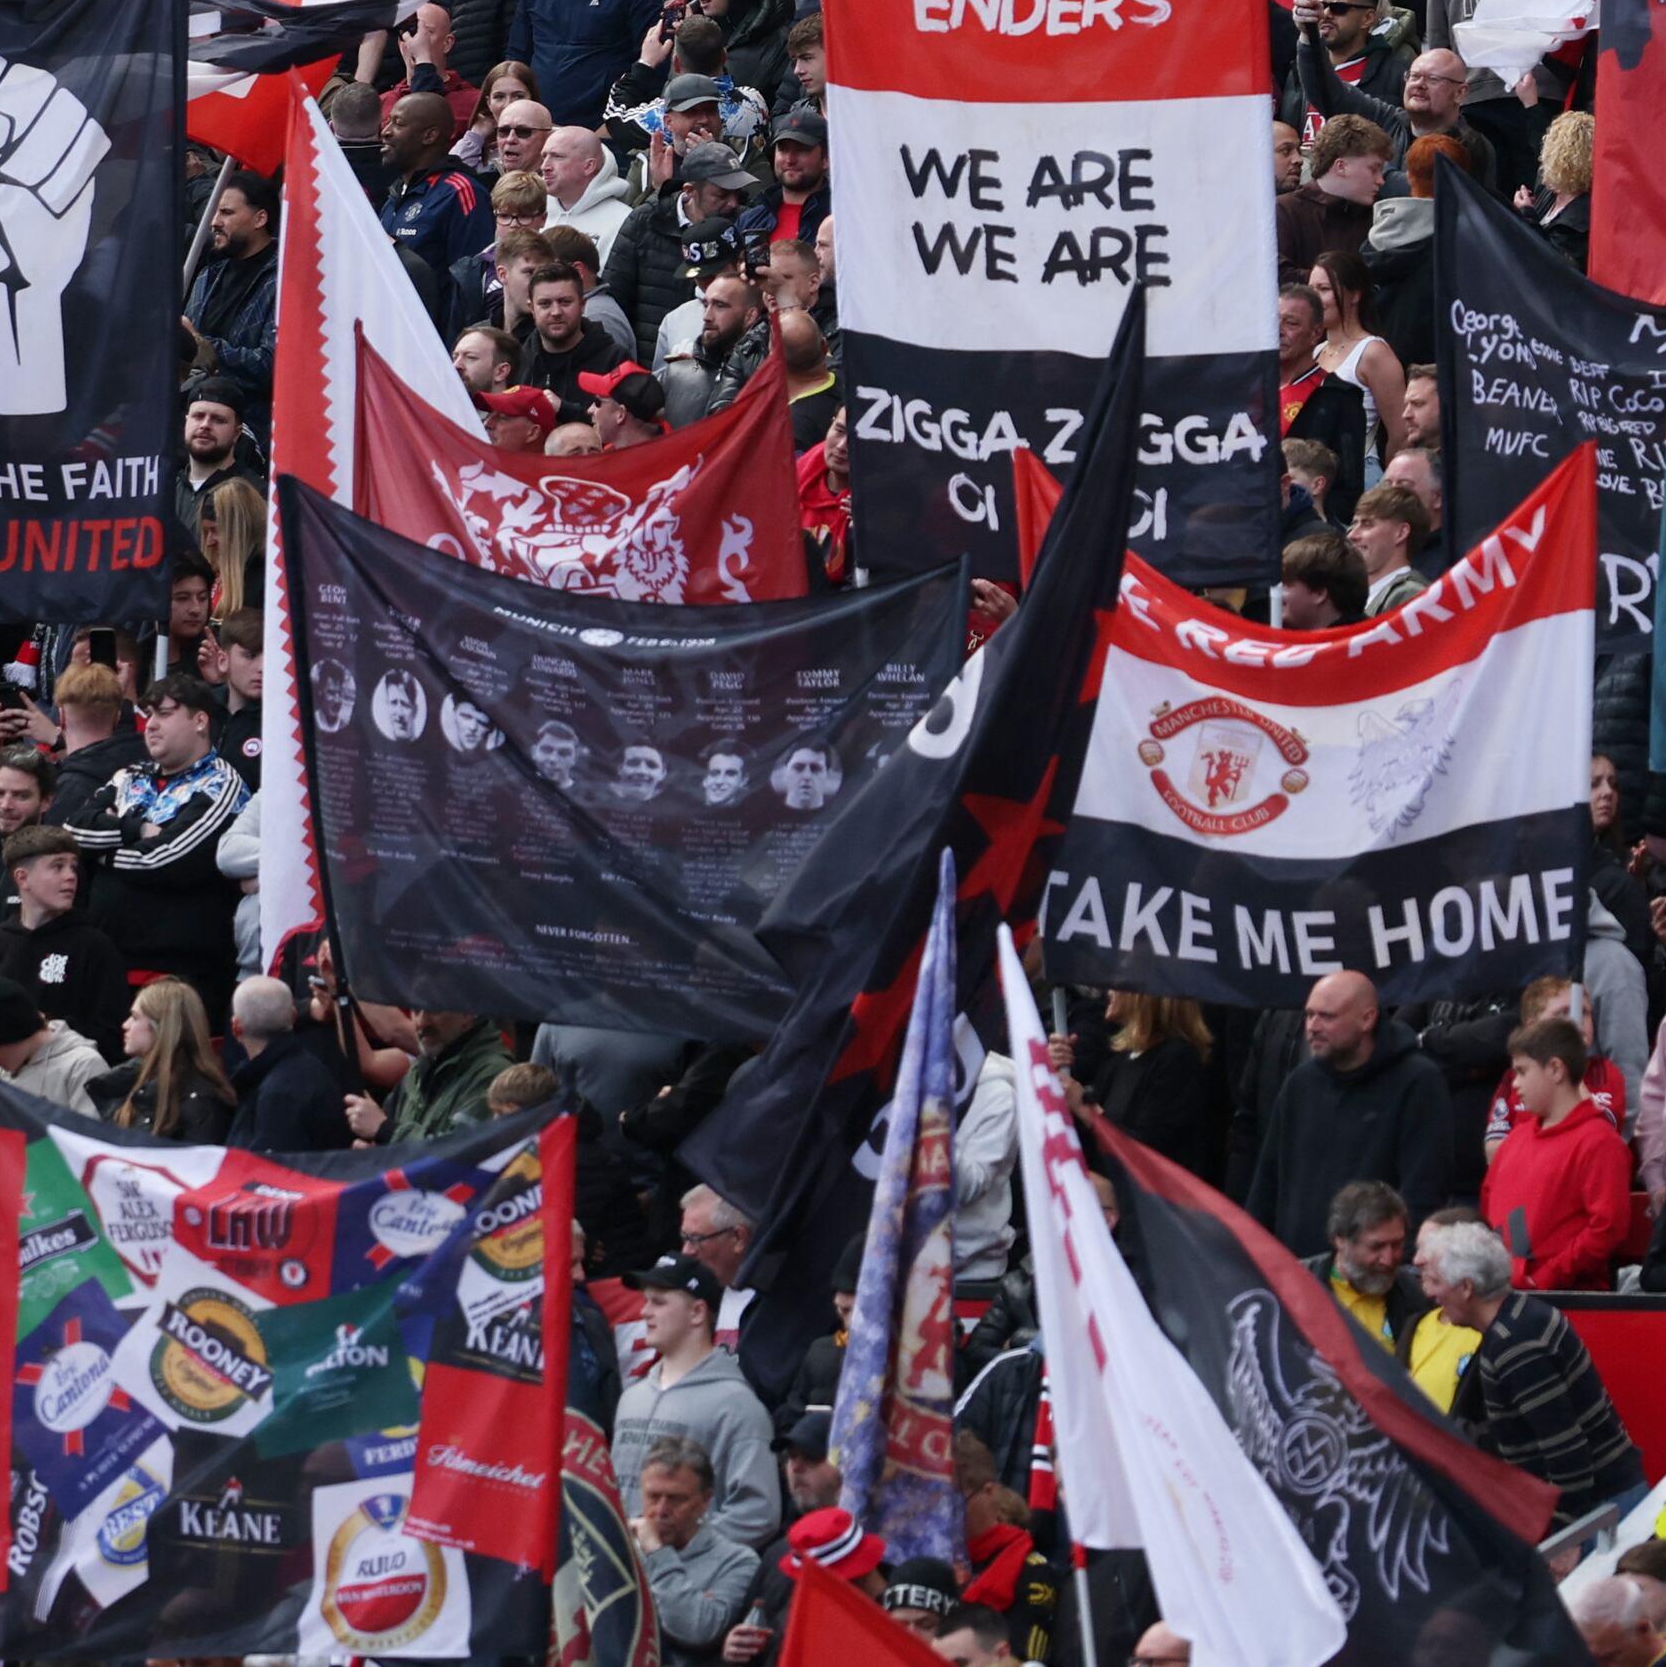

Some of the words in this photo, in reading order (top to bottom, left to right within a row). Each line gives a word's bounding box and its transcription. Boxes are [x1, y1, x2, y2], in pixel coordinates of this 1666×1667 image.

[899, 147, 1004, 212] WE
[1027, 149, 1156, 212] ARE
[911, 221, 1018, 283] WE
[1042, 223, 1171, 287] ARE
[854, 384, 1029, 464] ZIGGA
[1044, 408, 1268, 465] ZGGA
[1485, 427, 1550, 459] MUFC
[62, 455, 161, 502] FAITH
[1347, 505, 1548, 648] ARMY
[493, 607, 577, 636] MUNICH
[535, 923, 569, 938] NEVER
[1041, 870, 1218, 964] TAKE
[1234, 905, 1343, 976] ME
[1369, 869, 1574, 969] HOME
[166, 1310, 271, 1401] ROONEY
[178, 1499, 282, 1546] KEANE
